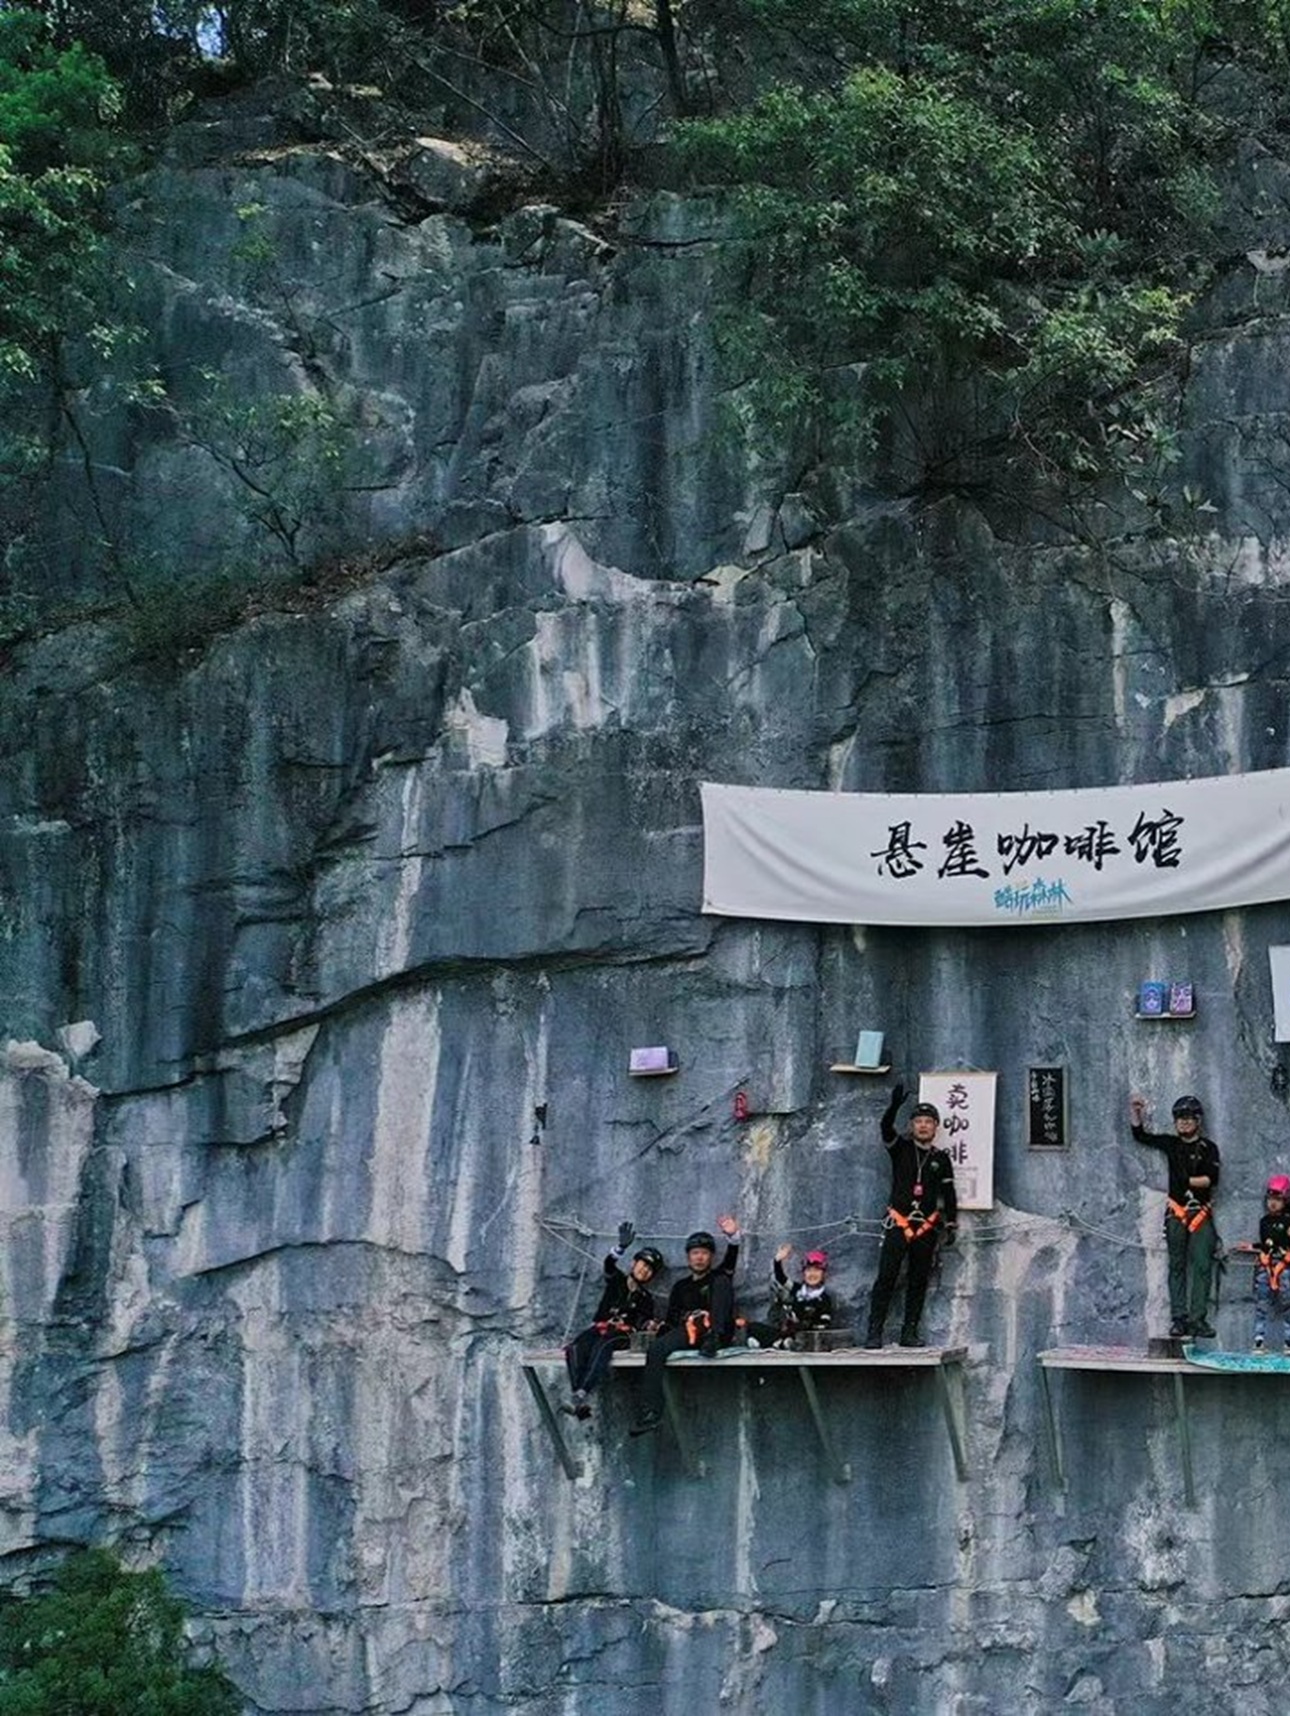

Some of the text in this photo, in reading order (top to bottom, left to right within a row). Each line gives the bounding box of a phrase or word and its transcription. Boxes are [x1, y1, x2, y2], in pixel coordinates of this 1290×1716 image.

[871, 809, 1185, 880] 悬崖咖啡馆
